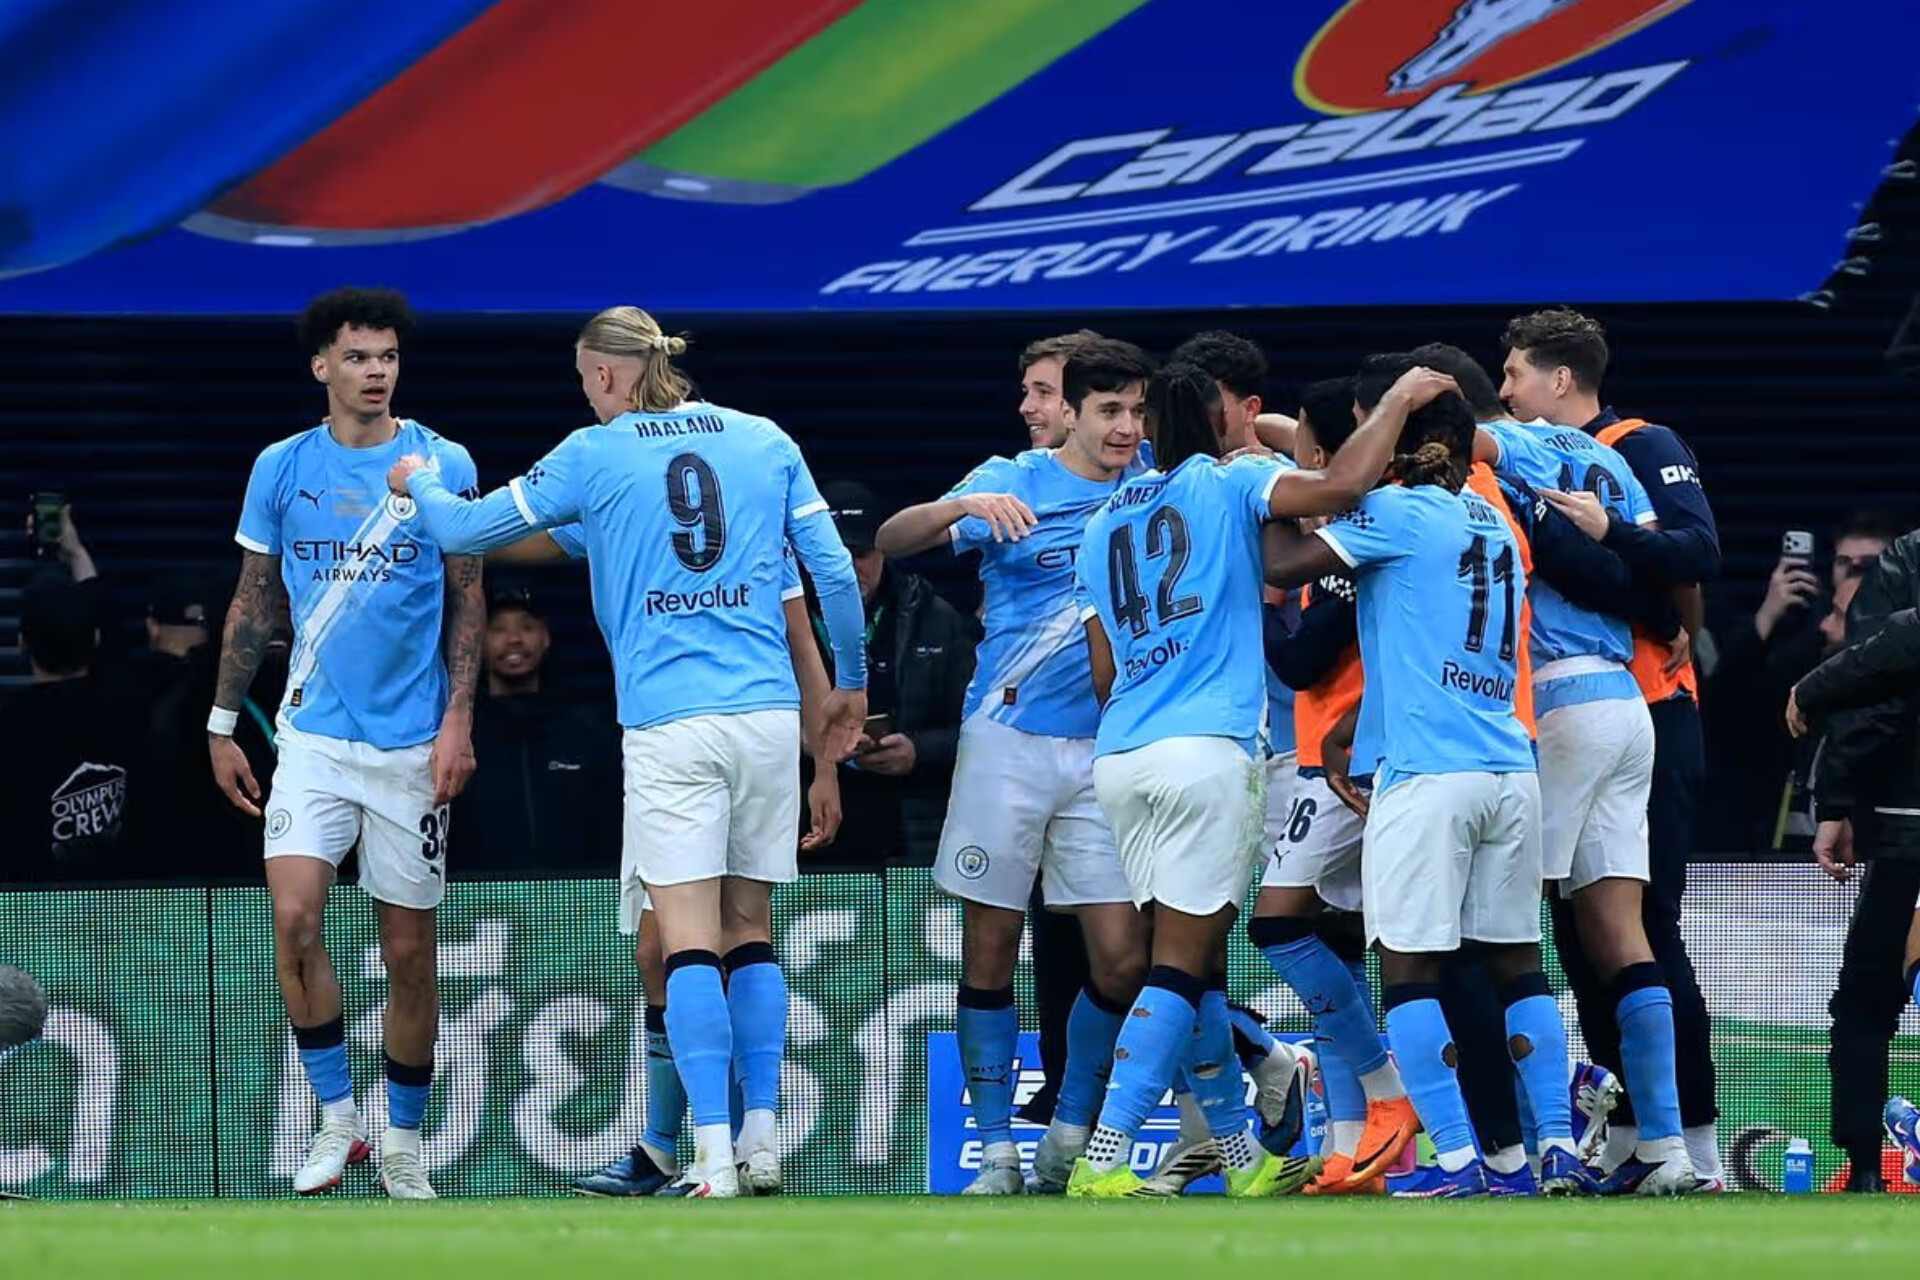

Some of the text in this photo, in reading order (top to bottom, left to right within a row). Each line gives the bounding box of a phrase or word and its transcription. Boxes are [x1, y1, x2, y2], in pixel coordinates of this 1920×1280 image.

[965, 60, 1692, 212] Carabao
[819, 184, 1523, 294] ENERGY DRINK
[635, 415, 725, 438] HAALAND
[666, 452, 727, 573] 9
[292, 541, 419, 563] ETIHAD
[312, 569, 391, 582] AIRWAYS
[1108, 503, 1204, 640] 42
[646, 583, 750, 616] Revolut
[1457, 534, 1515, 662] 11
[53, 797, 123, 840] CREW
